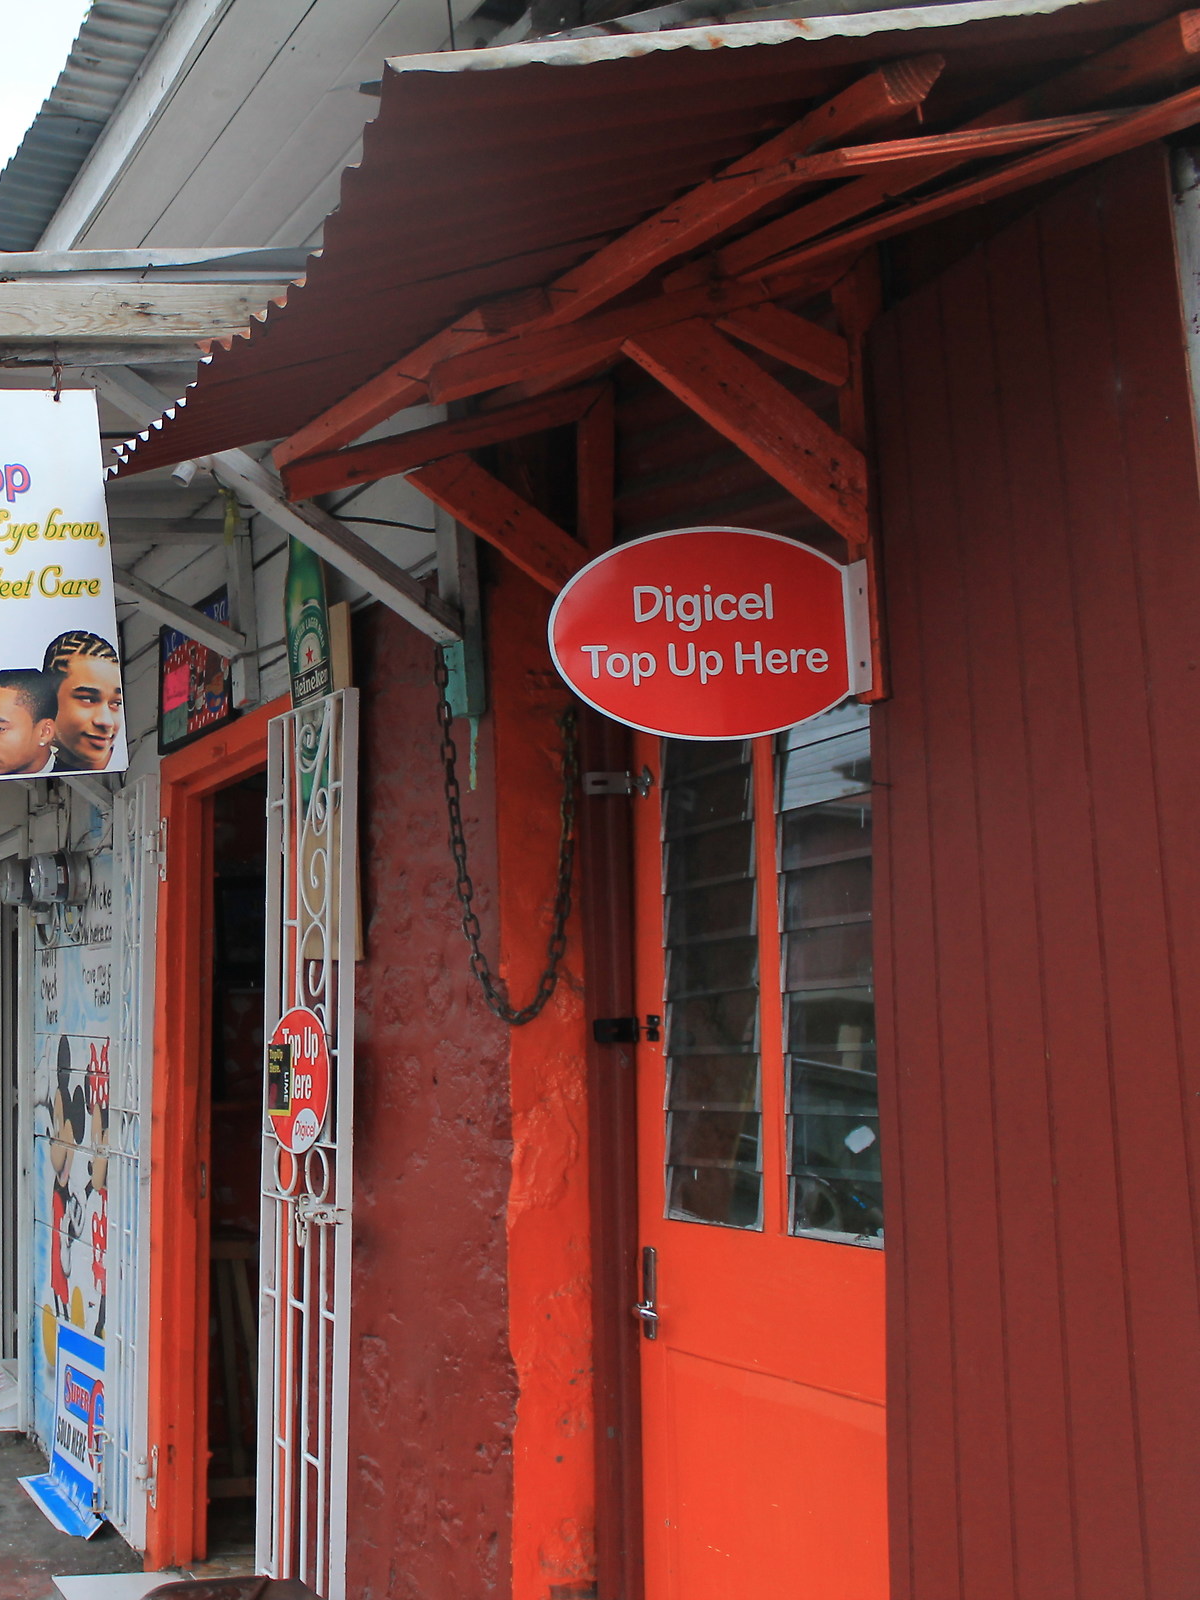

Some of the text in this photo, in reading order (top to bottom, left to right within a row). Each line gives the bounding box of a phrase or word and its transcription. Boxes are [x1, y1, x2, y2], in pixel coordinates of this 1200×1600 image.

[37, 565, 101, 597] Care
[633, 583, 774, 632] Digicel
[581, 640, 829, 686] Top Up Here
[294, 668, 328, 698] Heineken
[304, 1026, 319, 1066] Up
[295, 1119, 316, 1141] Digicel
